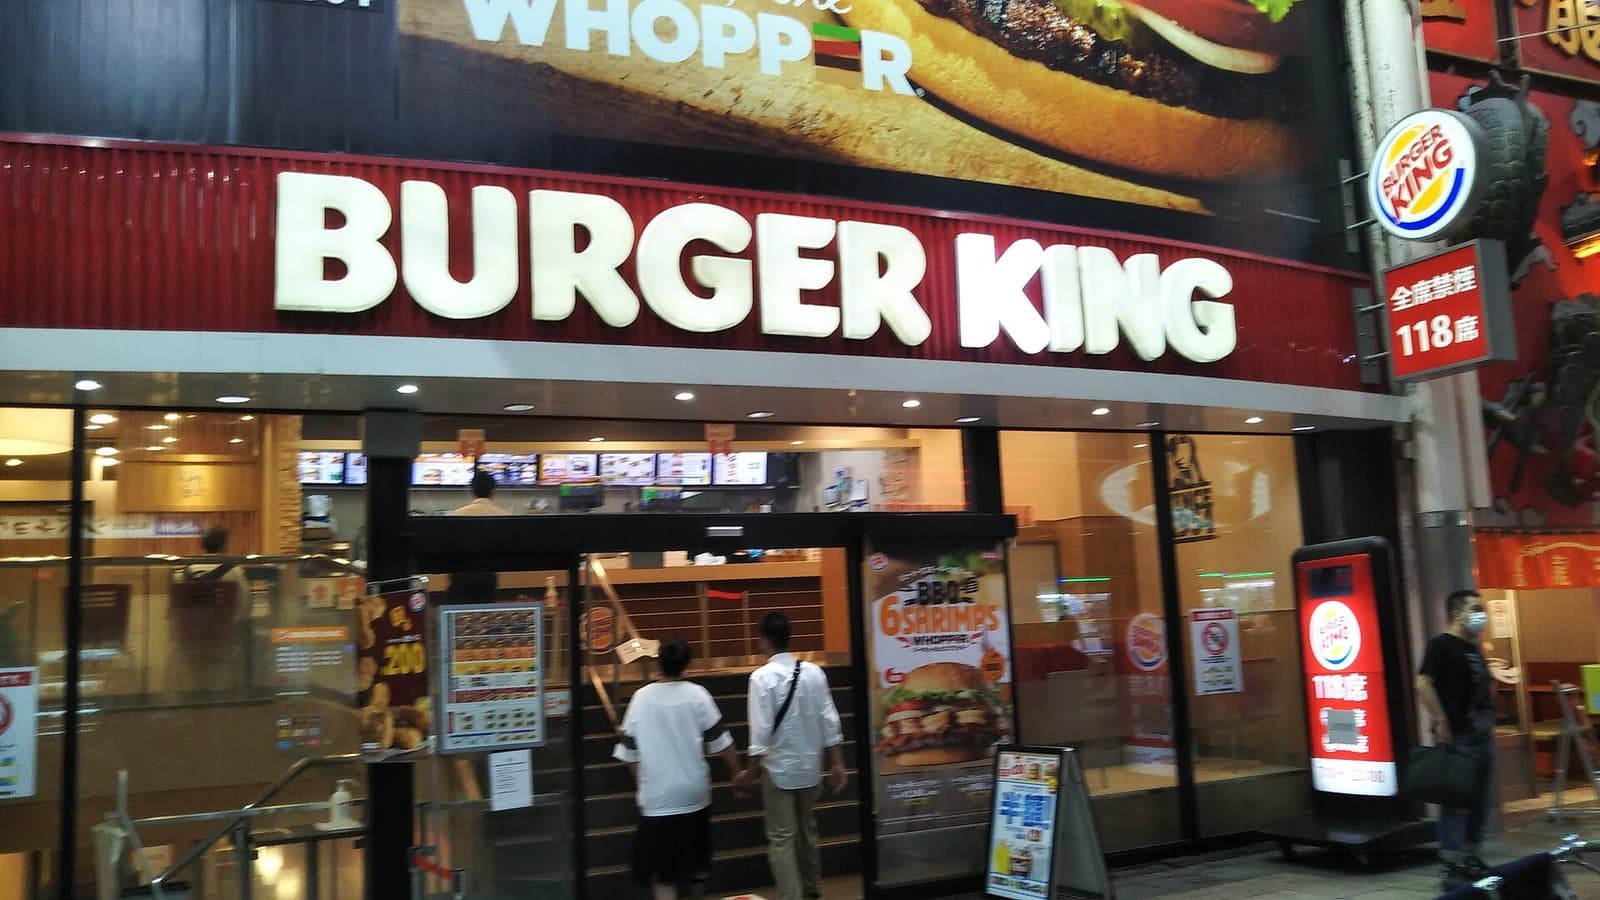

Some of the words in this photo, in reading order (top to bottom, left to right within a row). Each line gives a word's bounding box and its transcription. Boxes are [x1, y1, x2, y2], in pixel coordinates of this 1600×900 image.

[1382, 124, 1443, 198] BURGER
[1391, 139, 1454, 221] KING
[275, 171, 933, 346] BURGER
[956, 232, 1237, 363] KING
[1390, 264, 1478, 312] 全席禁煙
[1396, 314, 1480, 357] 118席
